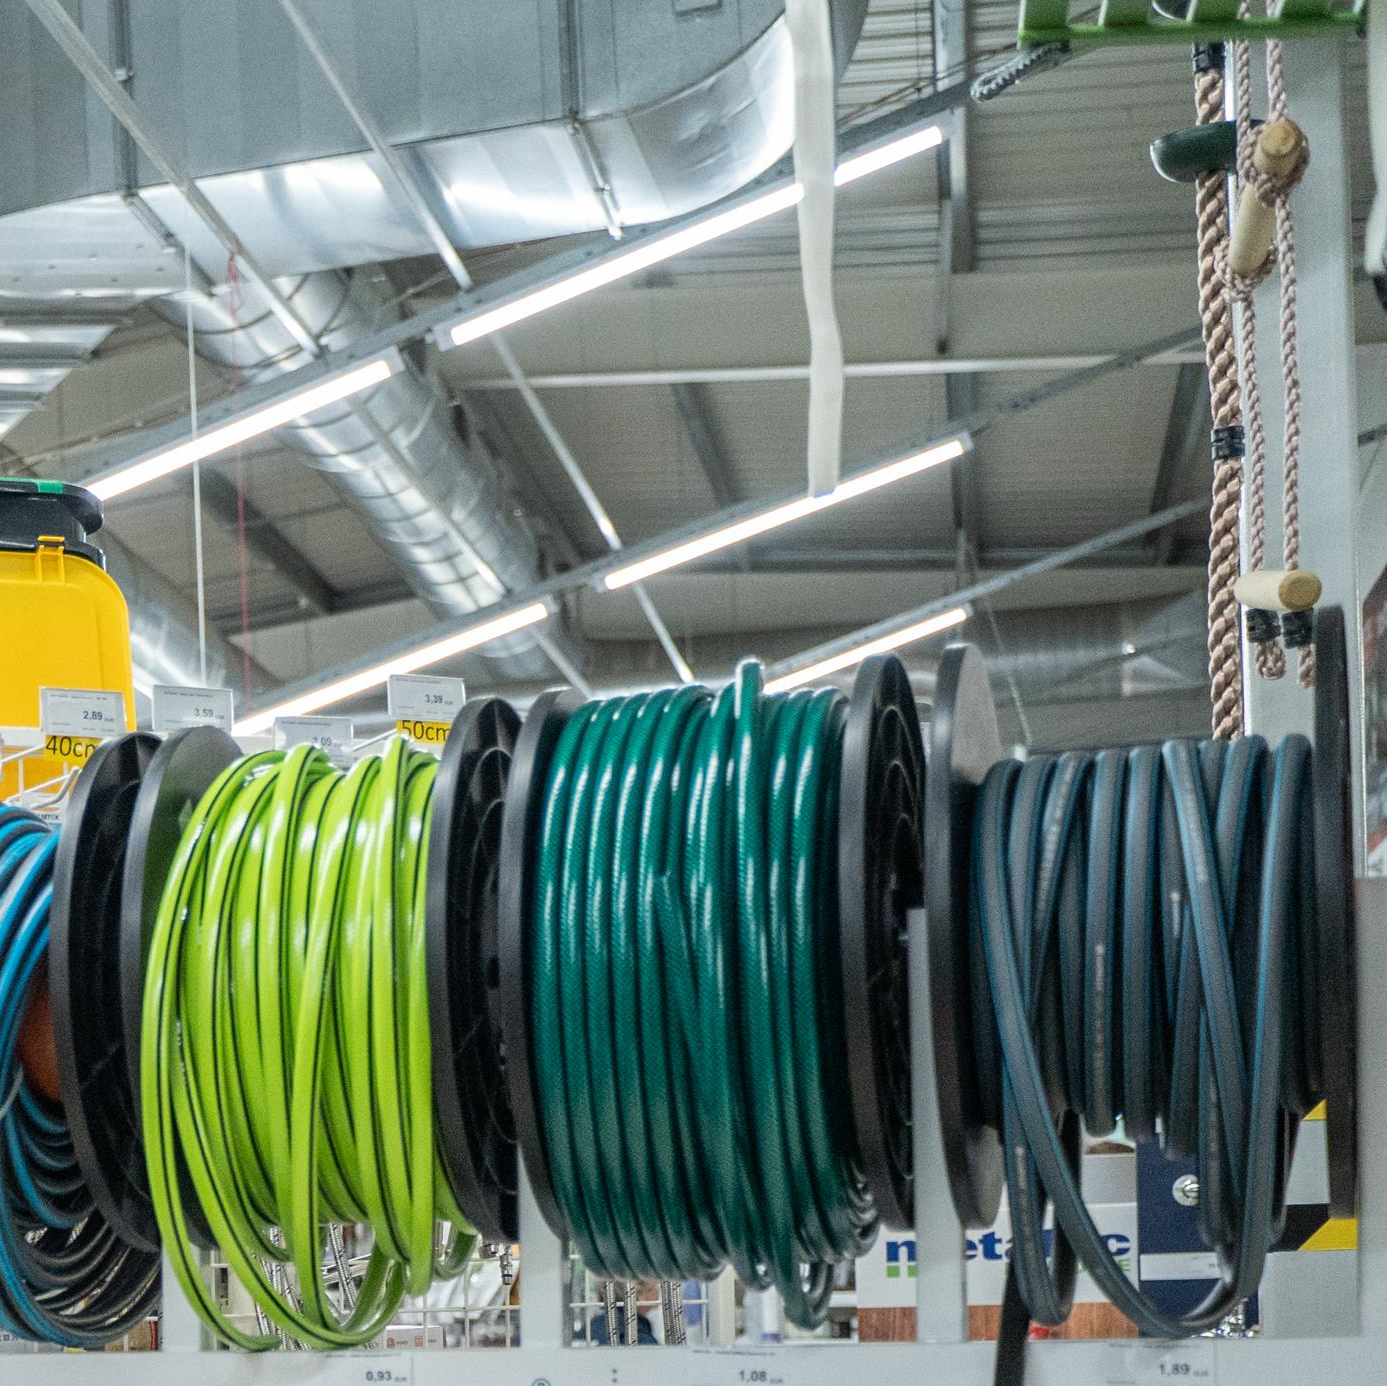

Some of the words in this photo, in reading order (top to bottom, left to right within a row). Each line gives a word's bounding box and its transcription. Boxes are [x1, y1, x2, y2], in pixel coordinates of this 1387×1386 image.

[83, 710, 103, 722] 2,89
[194, 707, 214, 719] 3,59
[738, 1369, 768, 1383] 1,08
[1157, 1362, 1190, 1377] 1,89
[365, 1370, 392, 1383] 0,93
